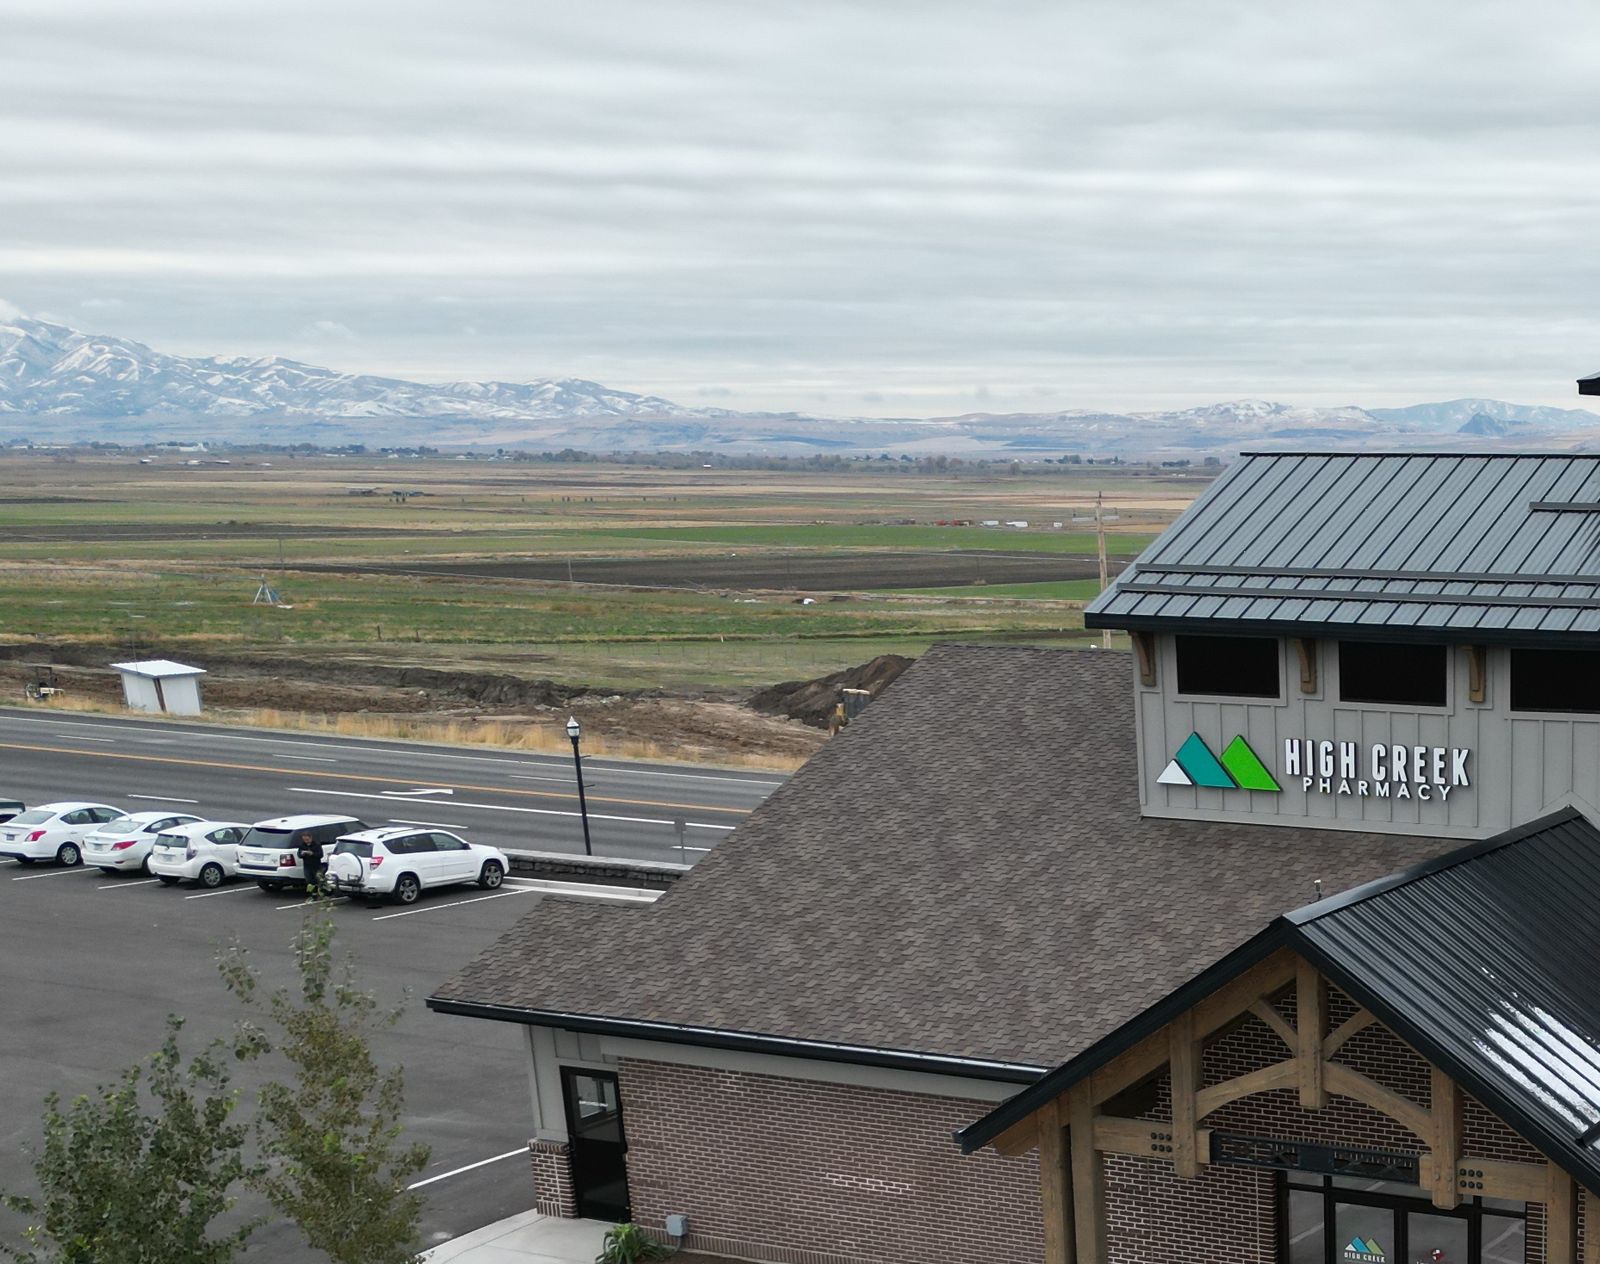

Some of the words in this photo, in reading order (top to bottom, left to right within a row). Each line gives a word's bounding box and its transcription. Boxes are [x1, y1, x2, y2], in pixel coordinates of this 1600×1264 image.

[1285, 738, 1356, 779] HIGH
[1372, 743, 1469, 786] CREEK
[1303, 777, 1452, 800] PHARMACY
